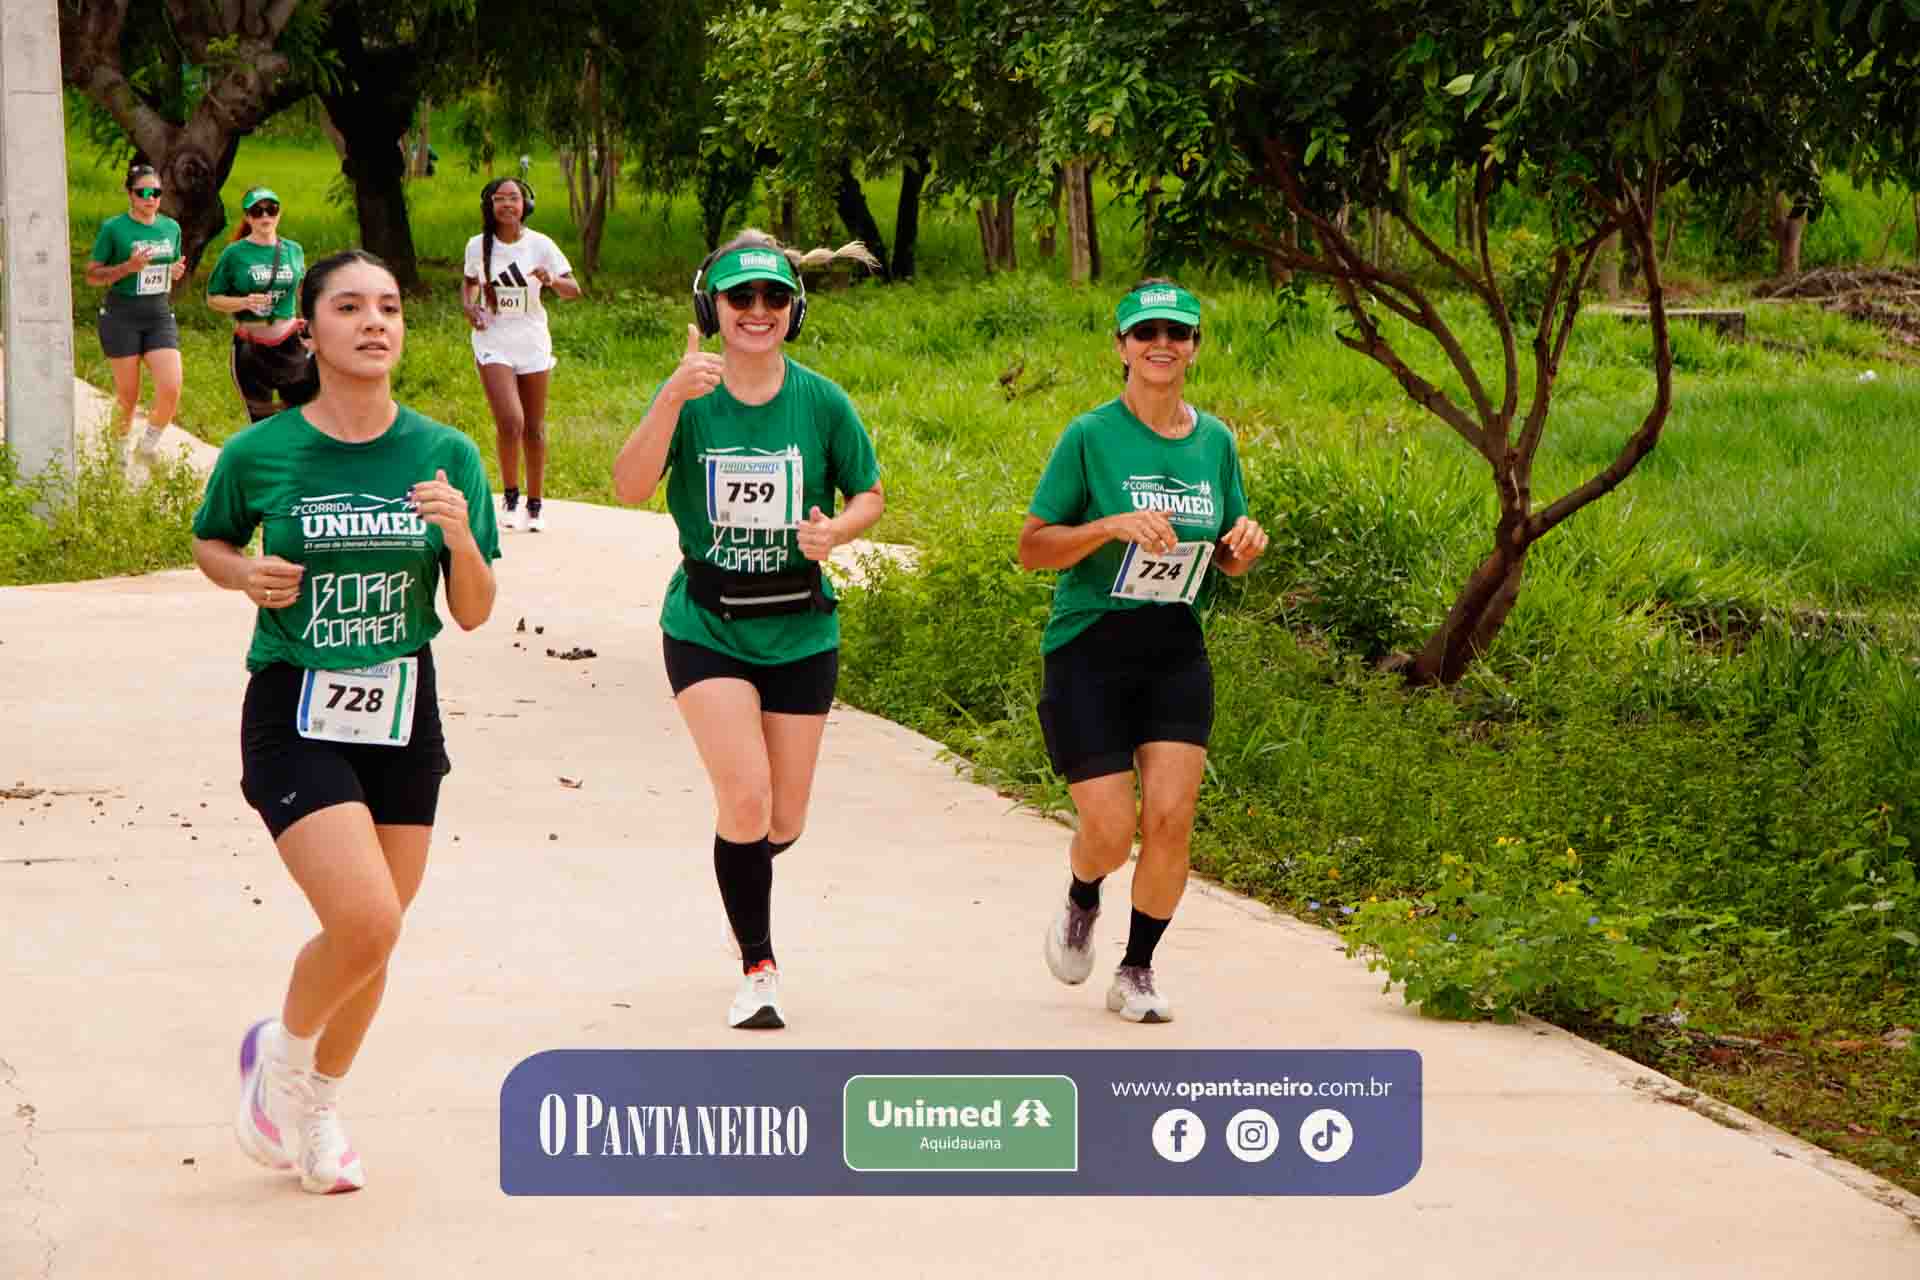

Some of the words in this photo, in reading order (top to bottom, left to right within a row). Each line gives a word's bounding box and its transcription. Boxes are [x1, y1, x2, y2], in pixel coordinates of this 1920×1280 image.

[727, 482, 775, 504] 759
[1130, 482, 1165, 493] CORRIDA
[301, 502, 353, 514] CORRIDA
[1131, 492, 1214, 516] UNIMED
[301, 511, 427, 538] UNIMED
[714, 546, 788, 573] CORRER
[1138, 560, 1183, 580] 724
[302, 571, 415, 639] BORA
[313, 611, 406, 648] CORRER
[326, 683, 385, 713] 728
